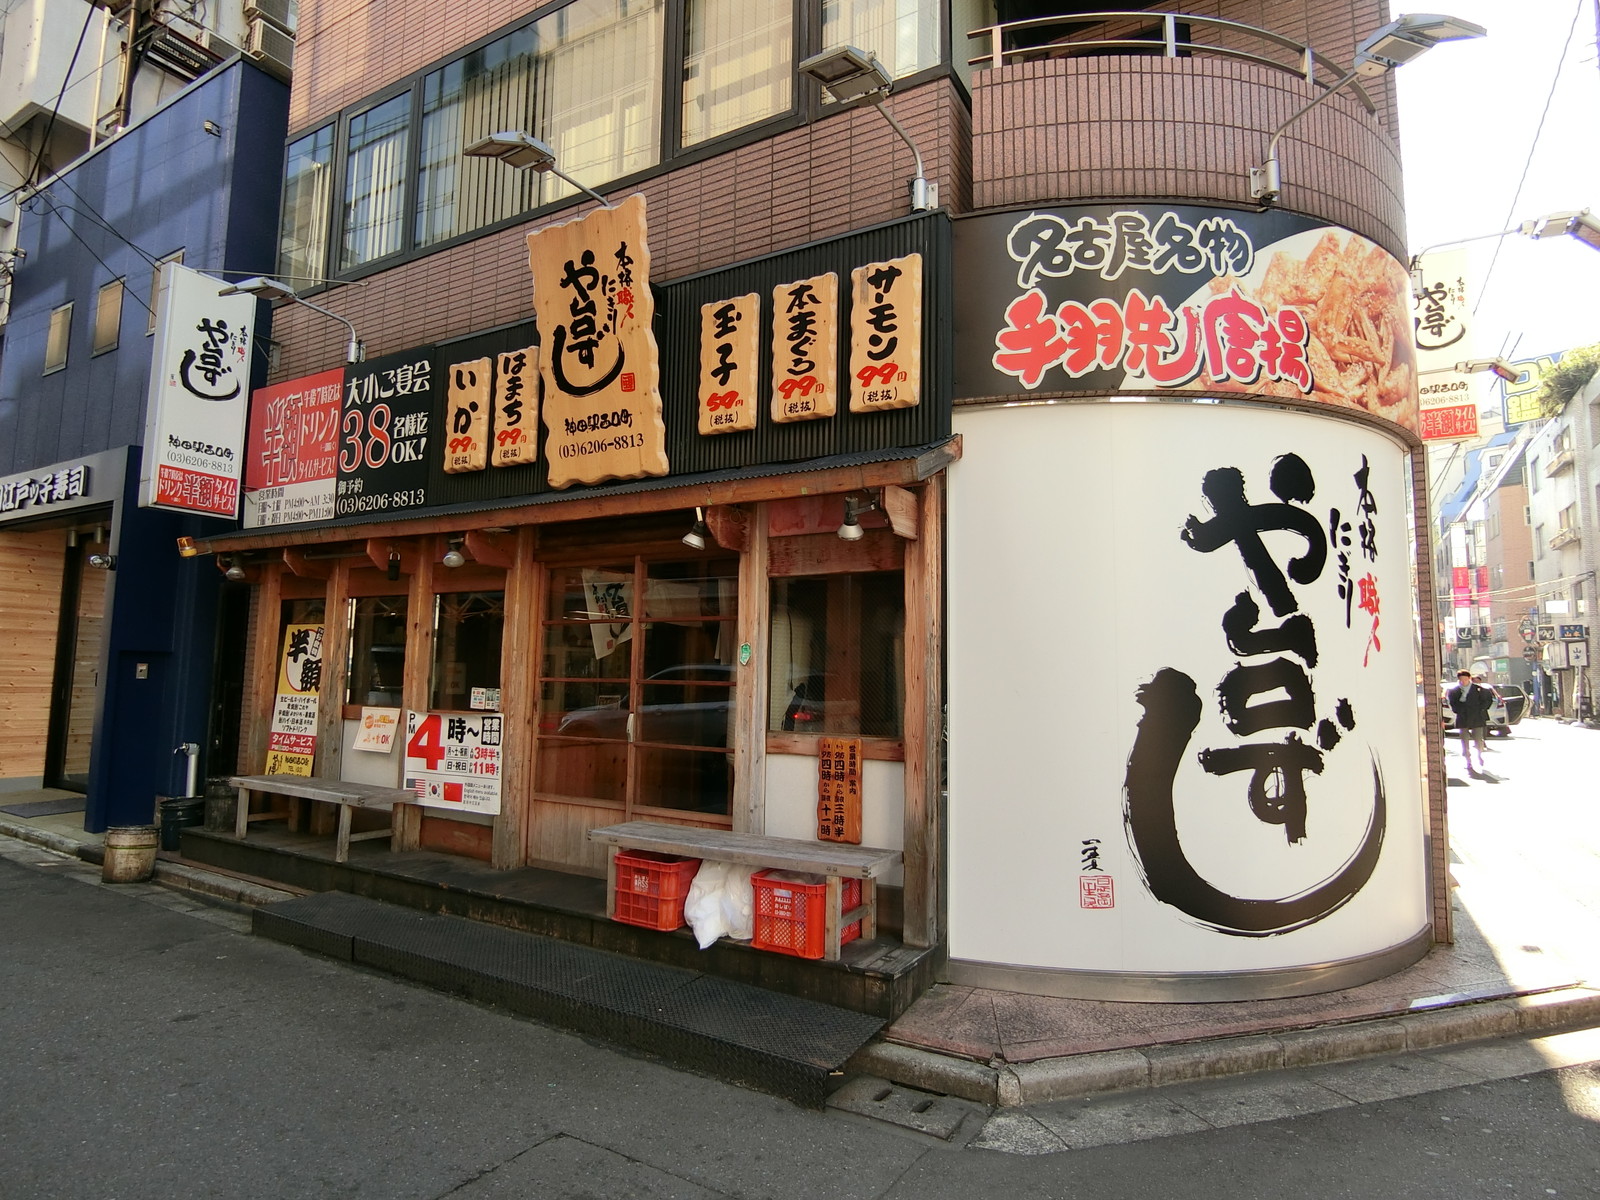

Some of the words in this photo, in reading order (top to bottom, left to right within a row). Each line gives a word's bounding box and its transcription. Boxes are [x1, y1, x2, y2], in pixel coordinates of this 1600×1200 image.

[1007, 210, 1254, 289] 名古屋名物
[786, 285, 821, 375] 本まぐろ
[866, 266, 902, 361] サーモン
[711, 304, 742, 386] 玉子
[345, 359, 431, 408] 大小ご宴会
[503, 353, 527, 426] はまち
[779, 376, 824, 399] 99円
[857, 363, 907, 387] 99円
[454, 369, 478, 434] いか
[300, 407, 339, 446] ドリンク
[339, 403, 391, 473] 38
[393, 411, 429, 439] 名様迄
[497, 428, 527, 447] 99円
[166, 450, 233, 473] (03)6206-8813
[391, 437, 428, 464] OK!
[558, 433, 644, 459] (03)6206-8813
[0, 465, 84, 511] 江戸ッ子寿司
[336, 488, 425, 515] (03)6206-8813
[272, 733, 313, 747] タイムサービス
